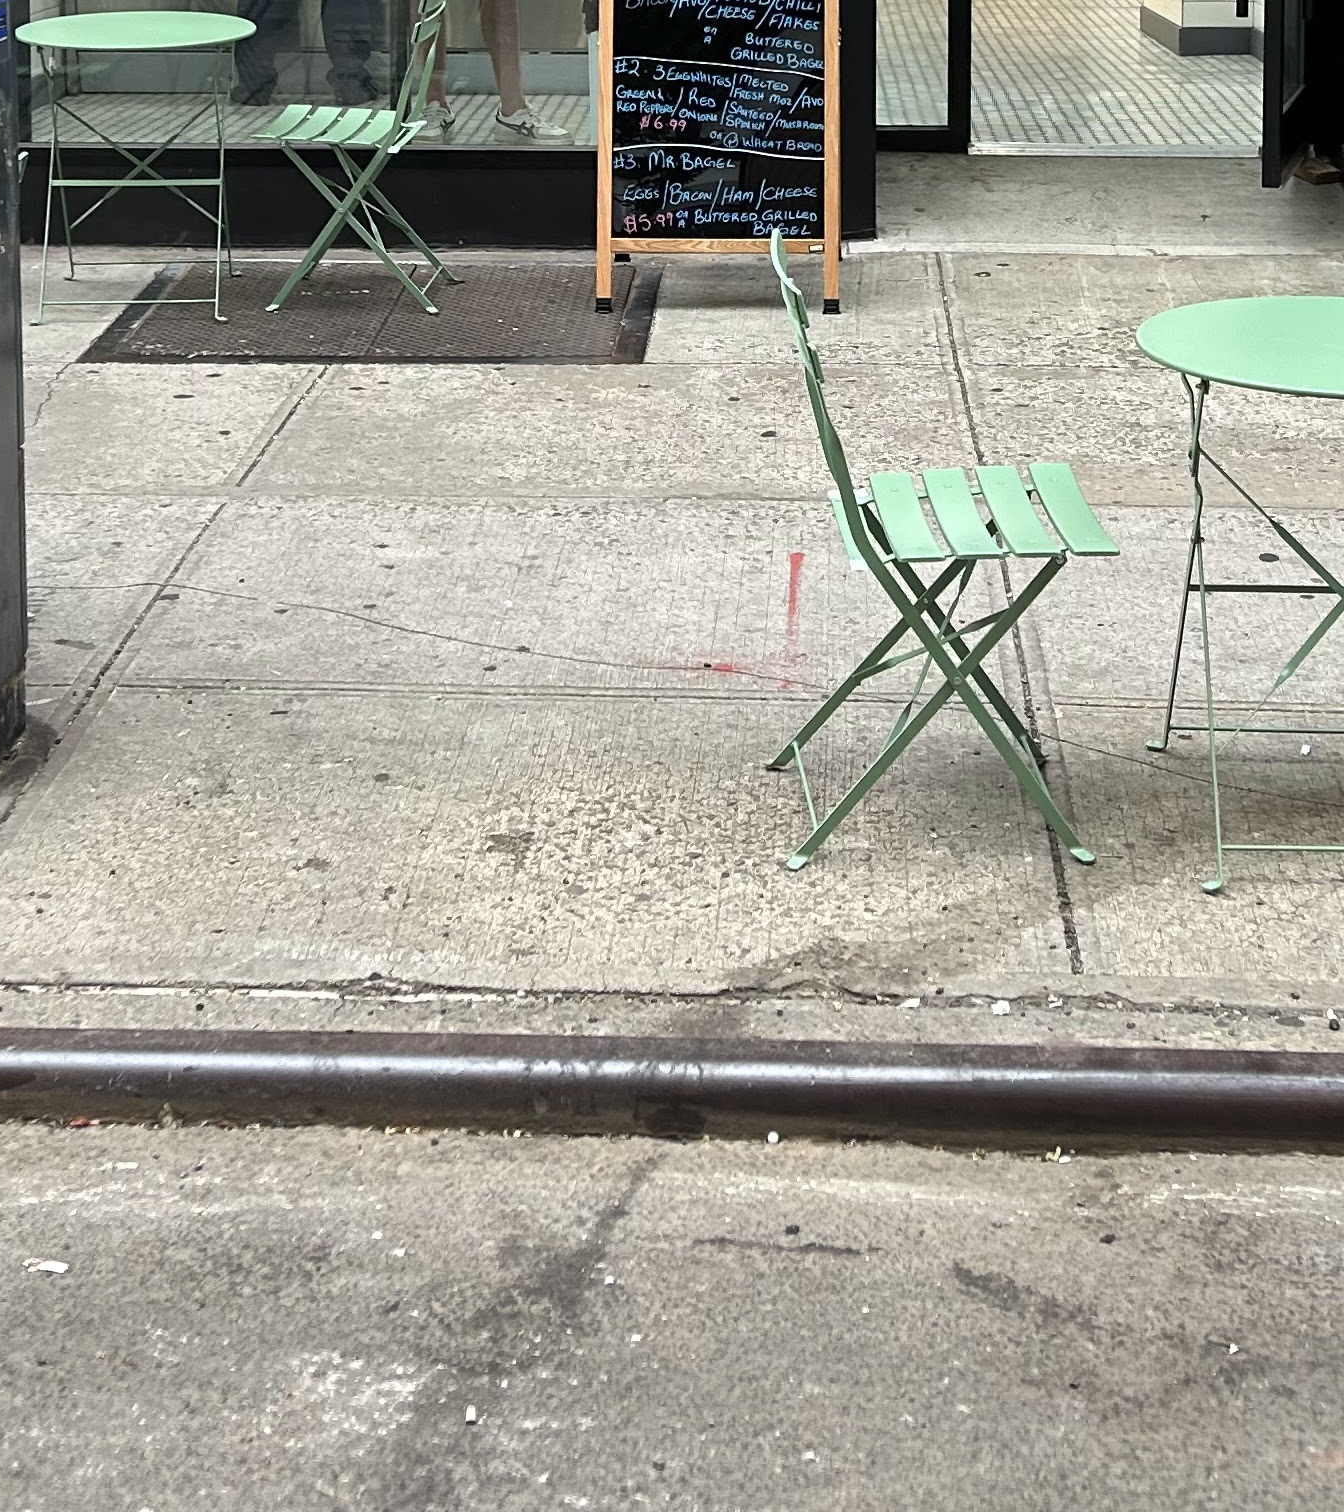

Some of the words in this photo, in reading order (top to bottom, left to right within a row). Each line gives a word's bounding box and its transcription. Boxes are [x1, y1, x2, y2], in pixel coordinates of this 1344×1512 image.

[745, 32, 815, 54] BUTTERED
[730, 47, 784, 65] GRILLED
[694, 208, 757, 224] BUTTERED
